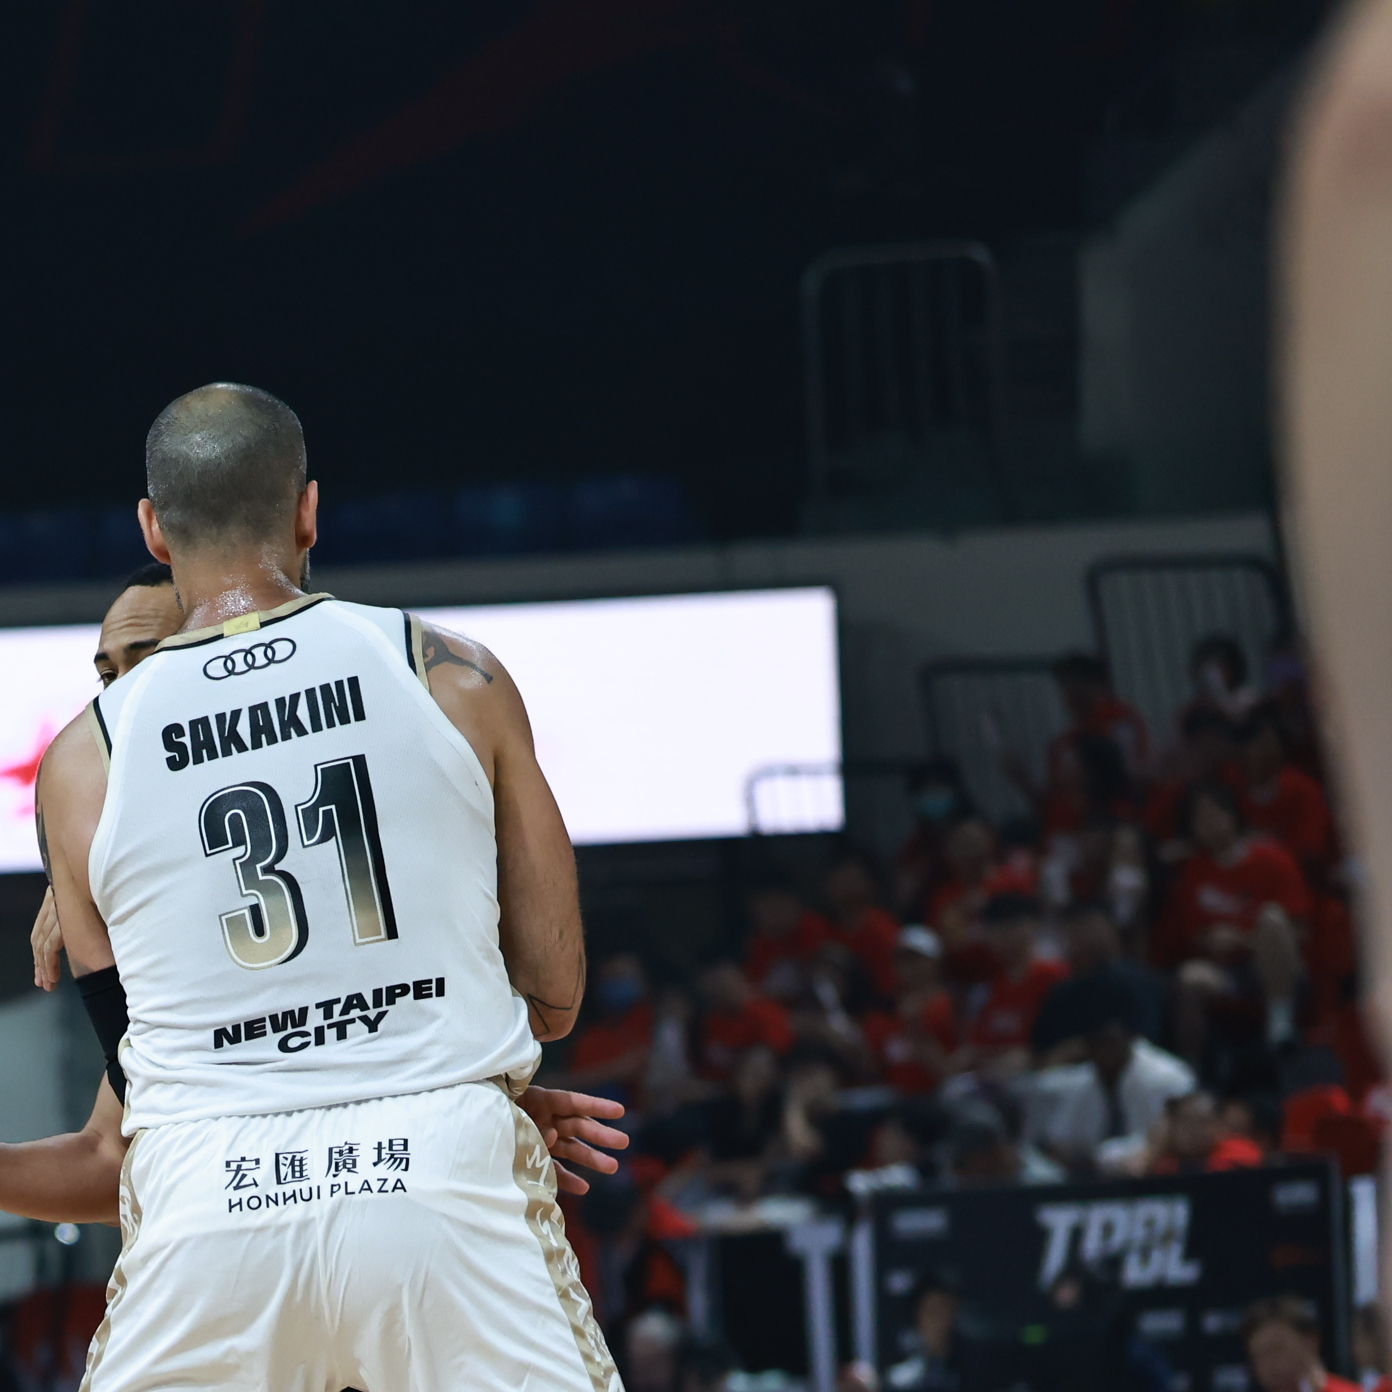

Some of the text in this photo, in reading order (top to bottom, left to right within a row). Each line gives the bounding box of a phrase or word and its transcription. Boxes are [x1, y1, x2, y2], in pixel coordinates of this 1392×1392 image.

[162, 675, 366, 772] SAKAKINI
[198, 754, 399, 971] 31
[214, 977, 445, 1049] NEW TAIPEI
[277, 1010, 389, 1054] CITY
[224, 1138, 411, 1191] 宏匯廣場
[228, 1178, 407, 1213] HONHUI PLAZA
[1037, 1195, 1201, 1290] TPBL
